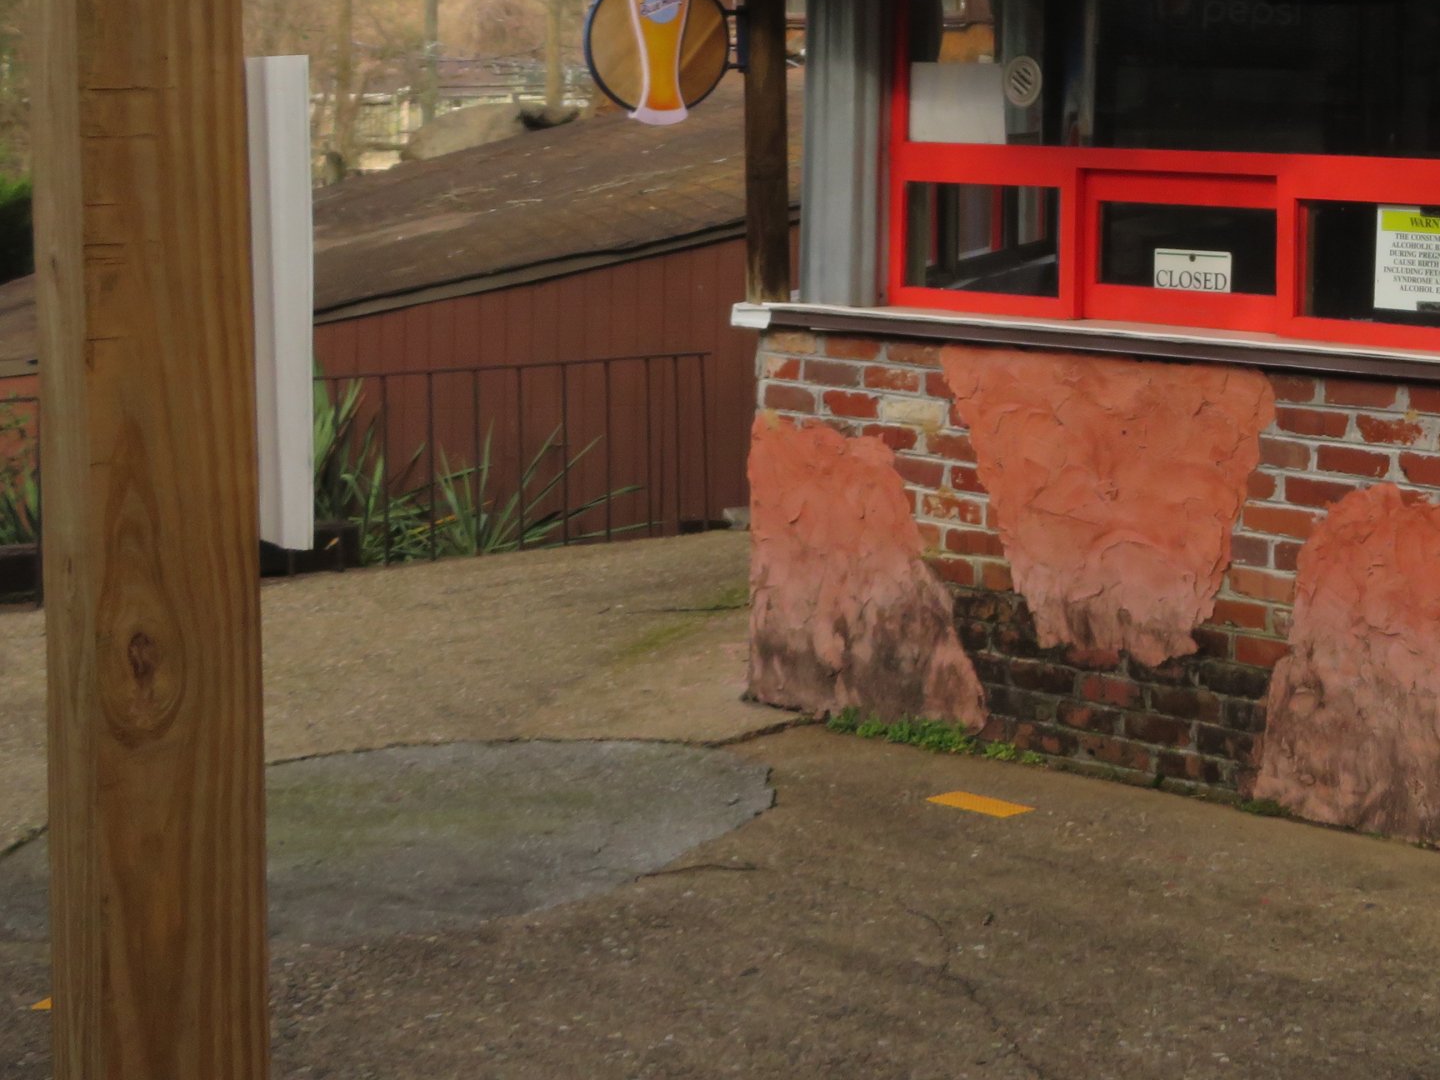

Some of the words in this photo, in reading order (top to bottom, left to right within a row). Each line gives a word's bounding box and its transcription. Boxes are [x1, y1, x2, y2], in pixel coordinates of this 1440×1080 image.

[1395, 232, 1409, 240] THE
[1392, 241, 1432, 251] ALCOHOLIC
[1389, 249, 1417, 258] DURING
[1393, 258, 1416, 266] CAUSE
[1417, 260, 1440, 268] BIRTH
[1383, 266, 1423, 275] INCLUDING
[1155, 269, 1228, 290] CLOSED
[1393, 275, 1432, 284] SYNDROME
[1400, 284, 1435, 293] ALCOHOL
